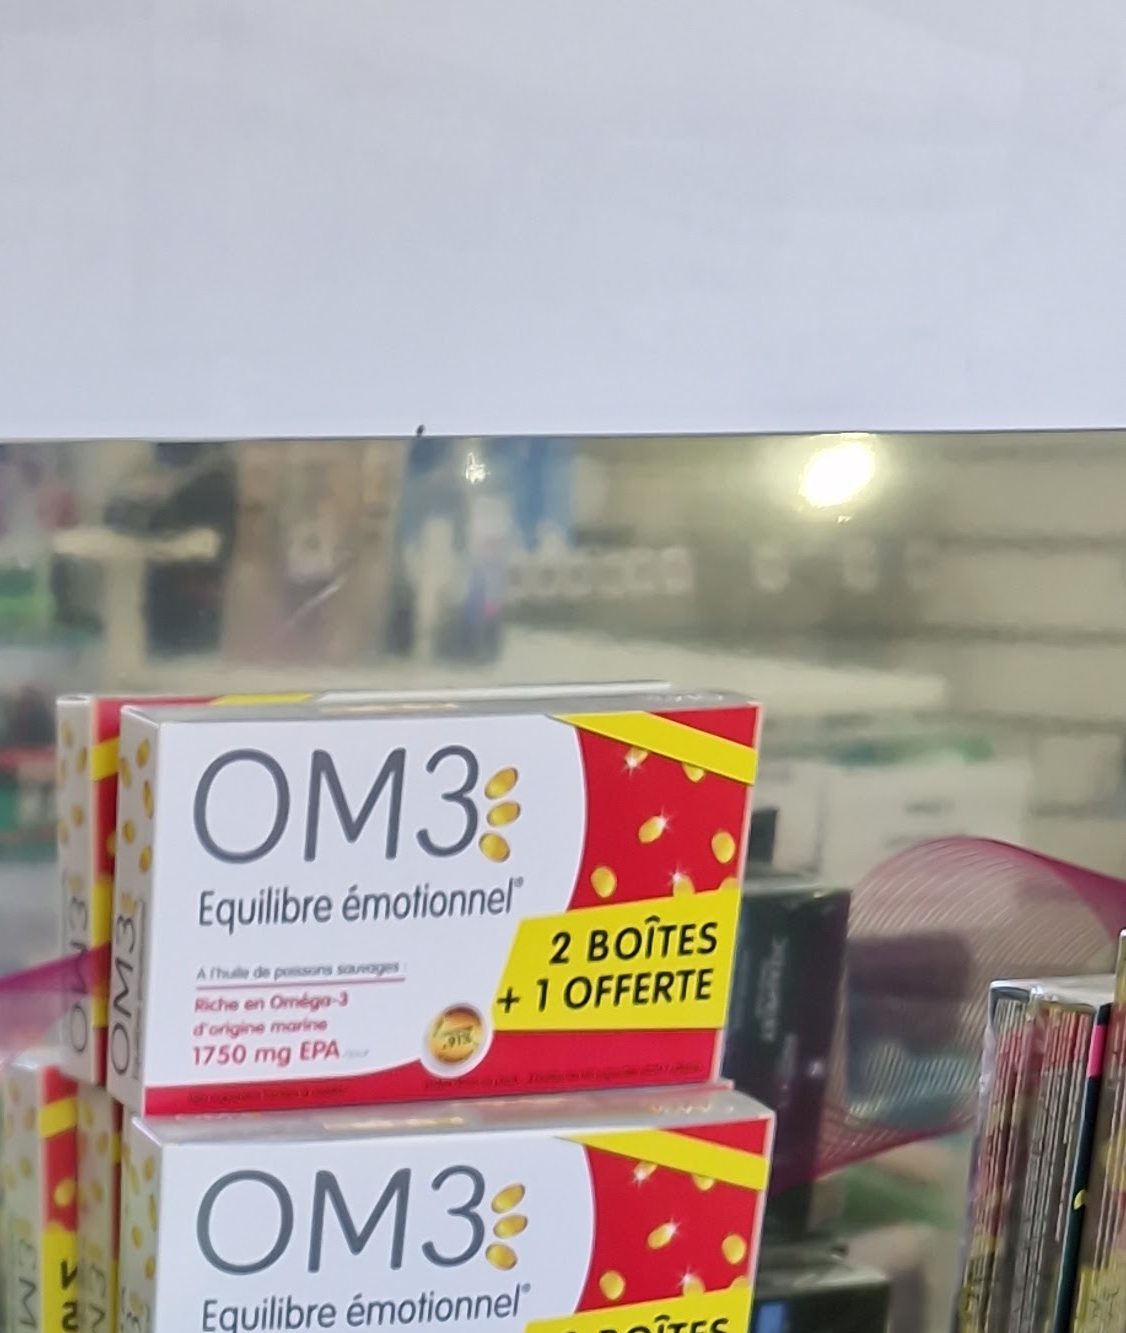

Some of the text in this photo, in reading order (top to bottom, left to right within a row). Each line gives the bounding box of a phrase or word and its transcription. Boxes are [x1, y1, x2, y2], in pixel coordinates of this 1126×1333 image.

[192, 743, 480, 865] OM3
[198, 885, 333, 935] Equilibre
[550, 914, 720, 966] 2 BOÎTES
[253, 964, 271, 980] de
[536, 977, 552, 1012] 1
[562, 967, 714, 1010] OFFERTE
[194, 990, 349, 1013] Riche en Oméga-3
[193, 1018, 328, 1040] d'origine marine
[193, 1039, 341, 1068] 1750 mg EPA
[196, 1163, 488, 1277] OM3
